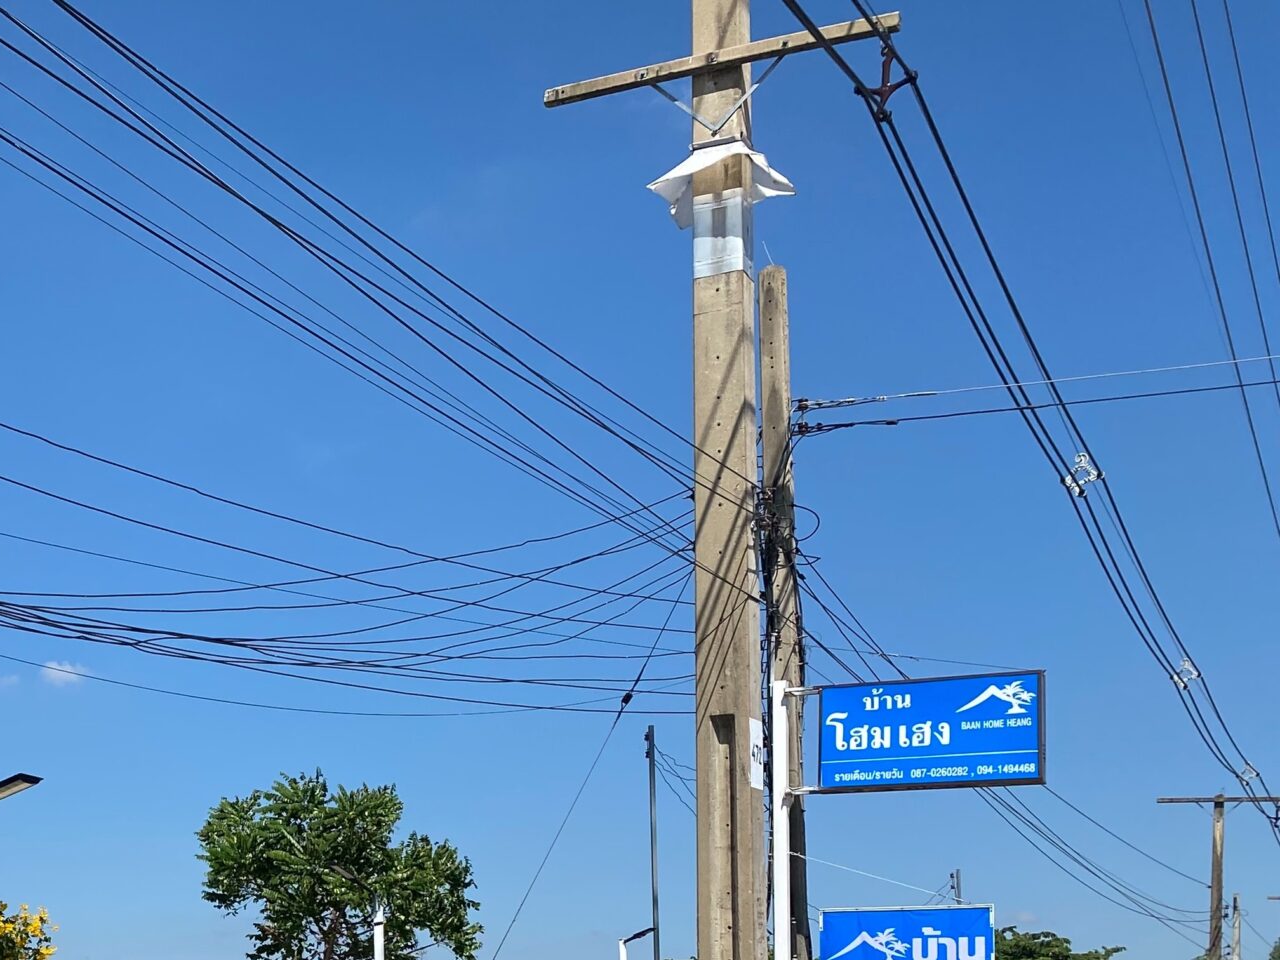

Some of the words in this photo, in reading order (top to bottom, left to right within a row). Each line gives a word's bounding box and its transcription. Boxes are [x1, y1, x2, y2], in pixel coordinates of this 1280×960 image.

[862, 688, 911, 711] บ้าน
[961, 721, 981, 730] BAAN
[983, 719, 1005, 729] HOME
[1006, 717, 1032, 728] HEANG
[976, 763, 1036, 776] 094-1494468
